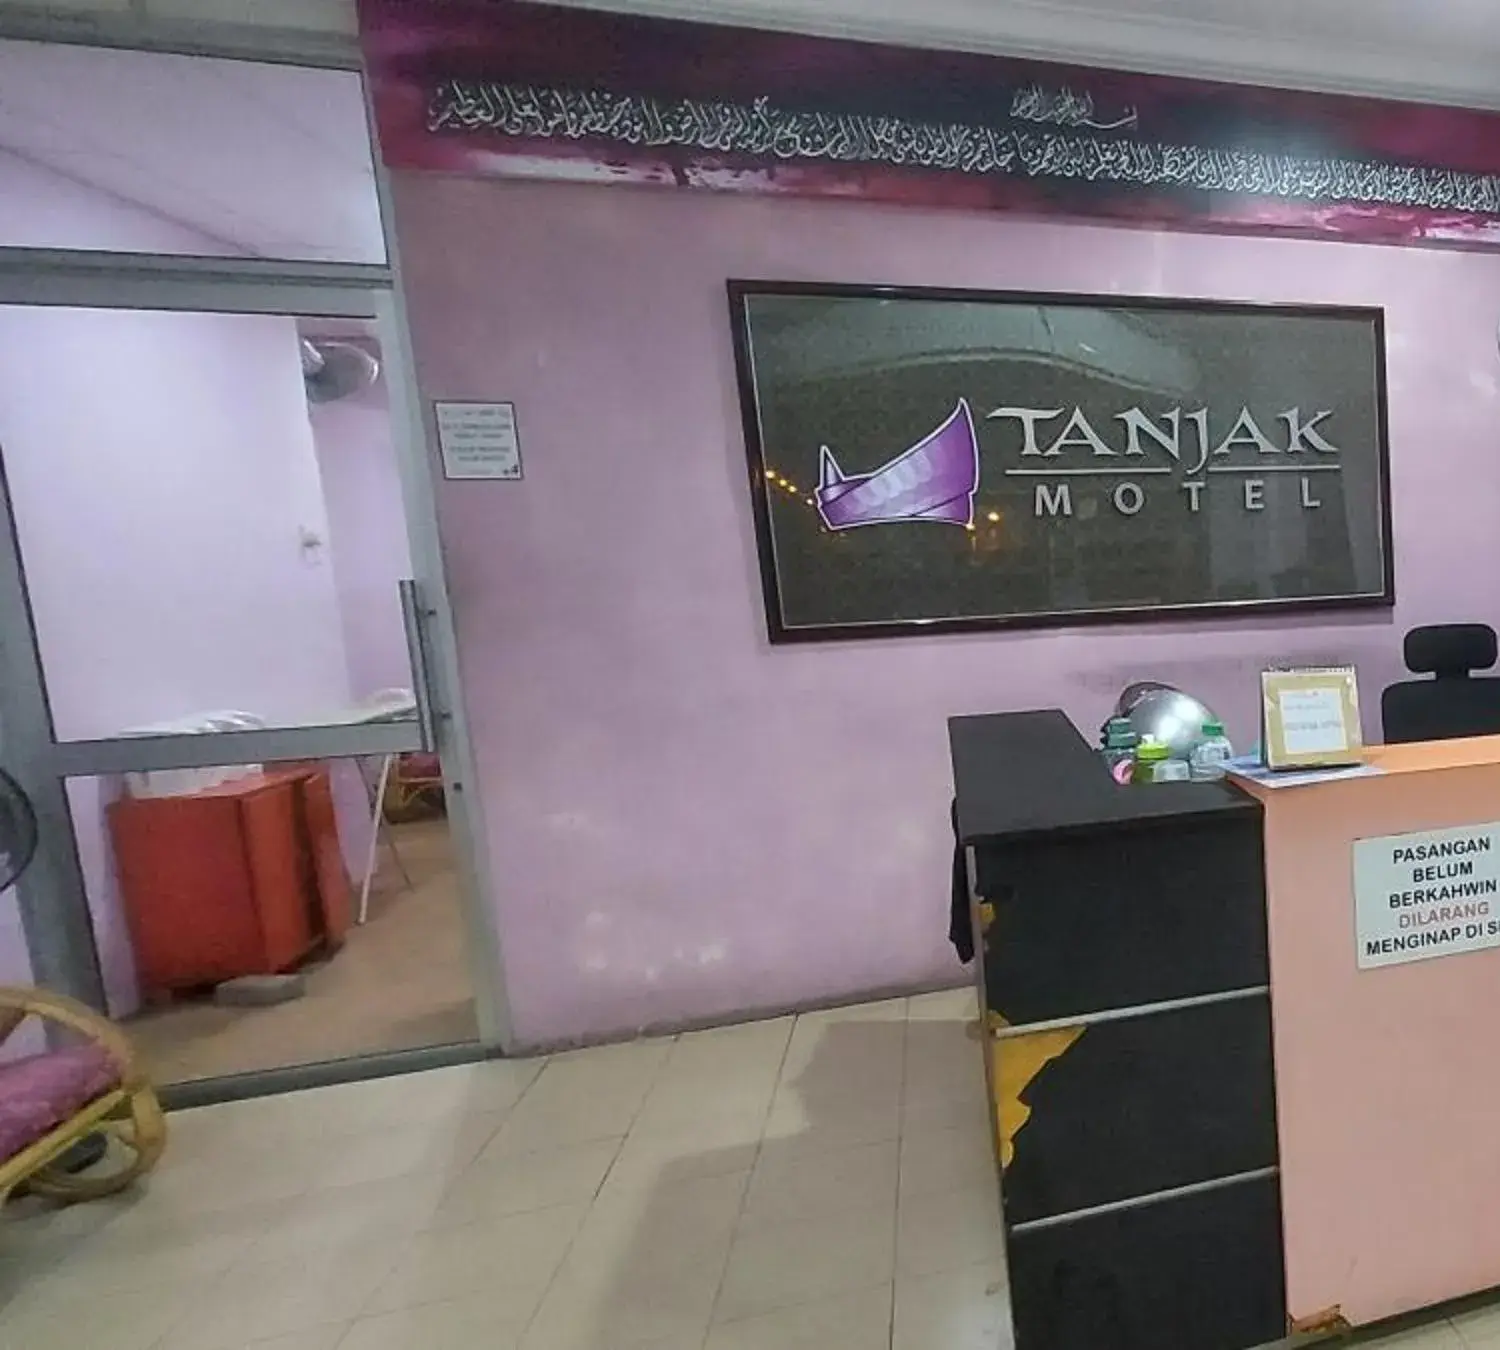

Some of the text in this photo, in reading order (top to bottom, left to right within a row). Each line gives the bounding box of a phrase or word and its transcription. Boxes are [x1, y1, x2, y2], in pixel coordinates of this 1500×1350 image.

[986, 405, 1341, 475] TANJAK
[1034, 479, 1322, 517] MOTEL
[1393, 836, 1491, 864] PASANGAN
[1413, 861, 1473, 883] BELUM
[1389, 880, 1498, 909] BERKAHWIN
[1399, 901, 1490, 929] DILARANG
[1366, 926, 1461, 956] MENGINAP
[1466, 922, 1483, 939] DI
